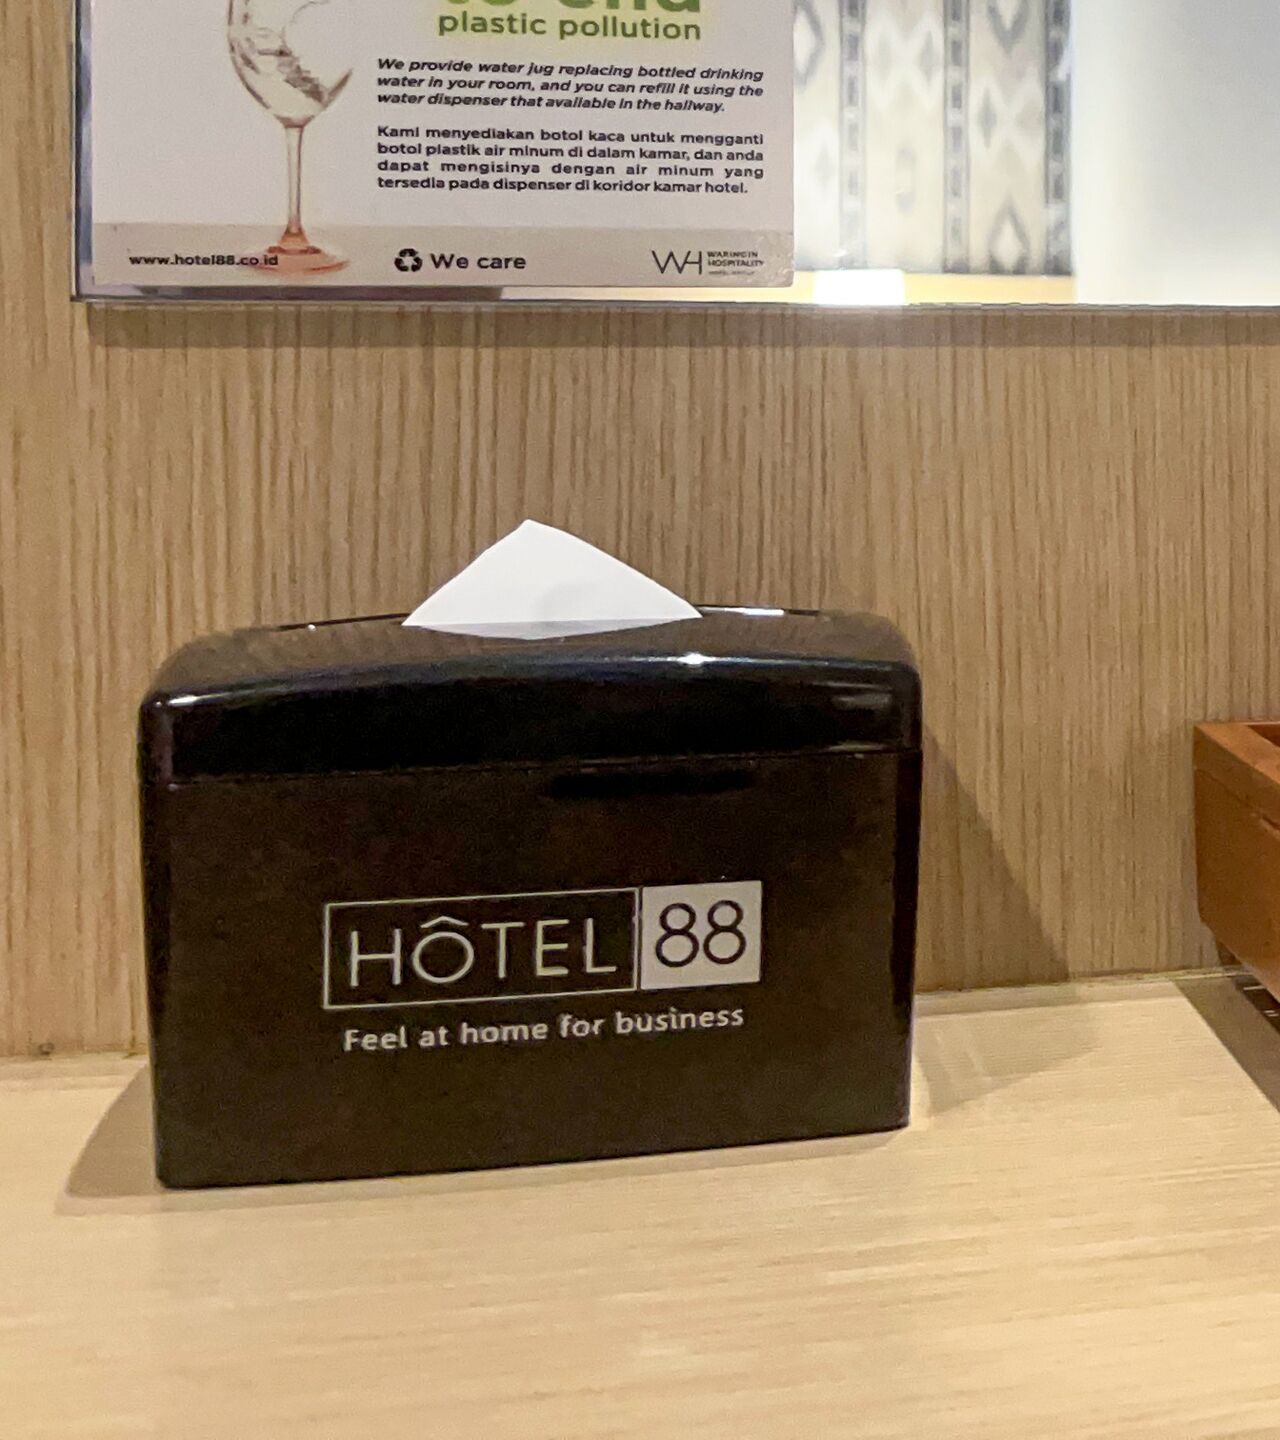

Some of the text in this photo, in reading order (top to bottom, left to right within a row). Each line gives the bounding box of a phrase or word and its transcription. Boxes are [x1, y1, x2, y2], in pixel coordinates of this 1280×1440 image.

[438, 11, 700, 40] plastic pollution
[378, 58, 764, 82] We provide water jug replacing bottled drinking
[377, 76, 764, 98] water in your room, and you can refill it using the
[377, 93, 725, 113] water dispenser that available in the hallway.
[378, 125, 764, 146] Kami menyediakan botol kaca untuk mengganti
[378, 142, 764, 161] botol plastik air minum di dalam kamar, dan anda
[377, 160, 764, 179] dapat mengisinya dengan air minum yang
[378, 177, 748, 194] tersedia pada dispenser di koridor kamar hotel.
[129, 253, 279, 267] www.hotel88.co.id
[431, 253, 527, 270] We care
[350, 899, 747, 987] HÔTEL 88
[344, 1006, 744, 1052] Feel at home for business
